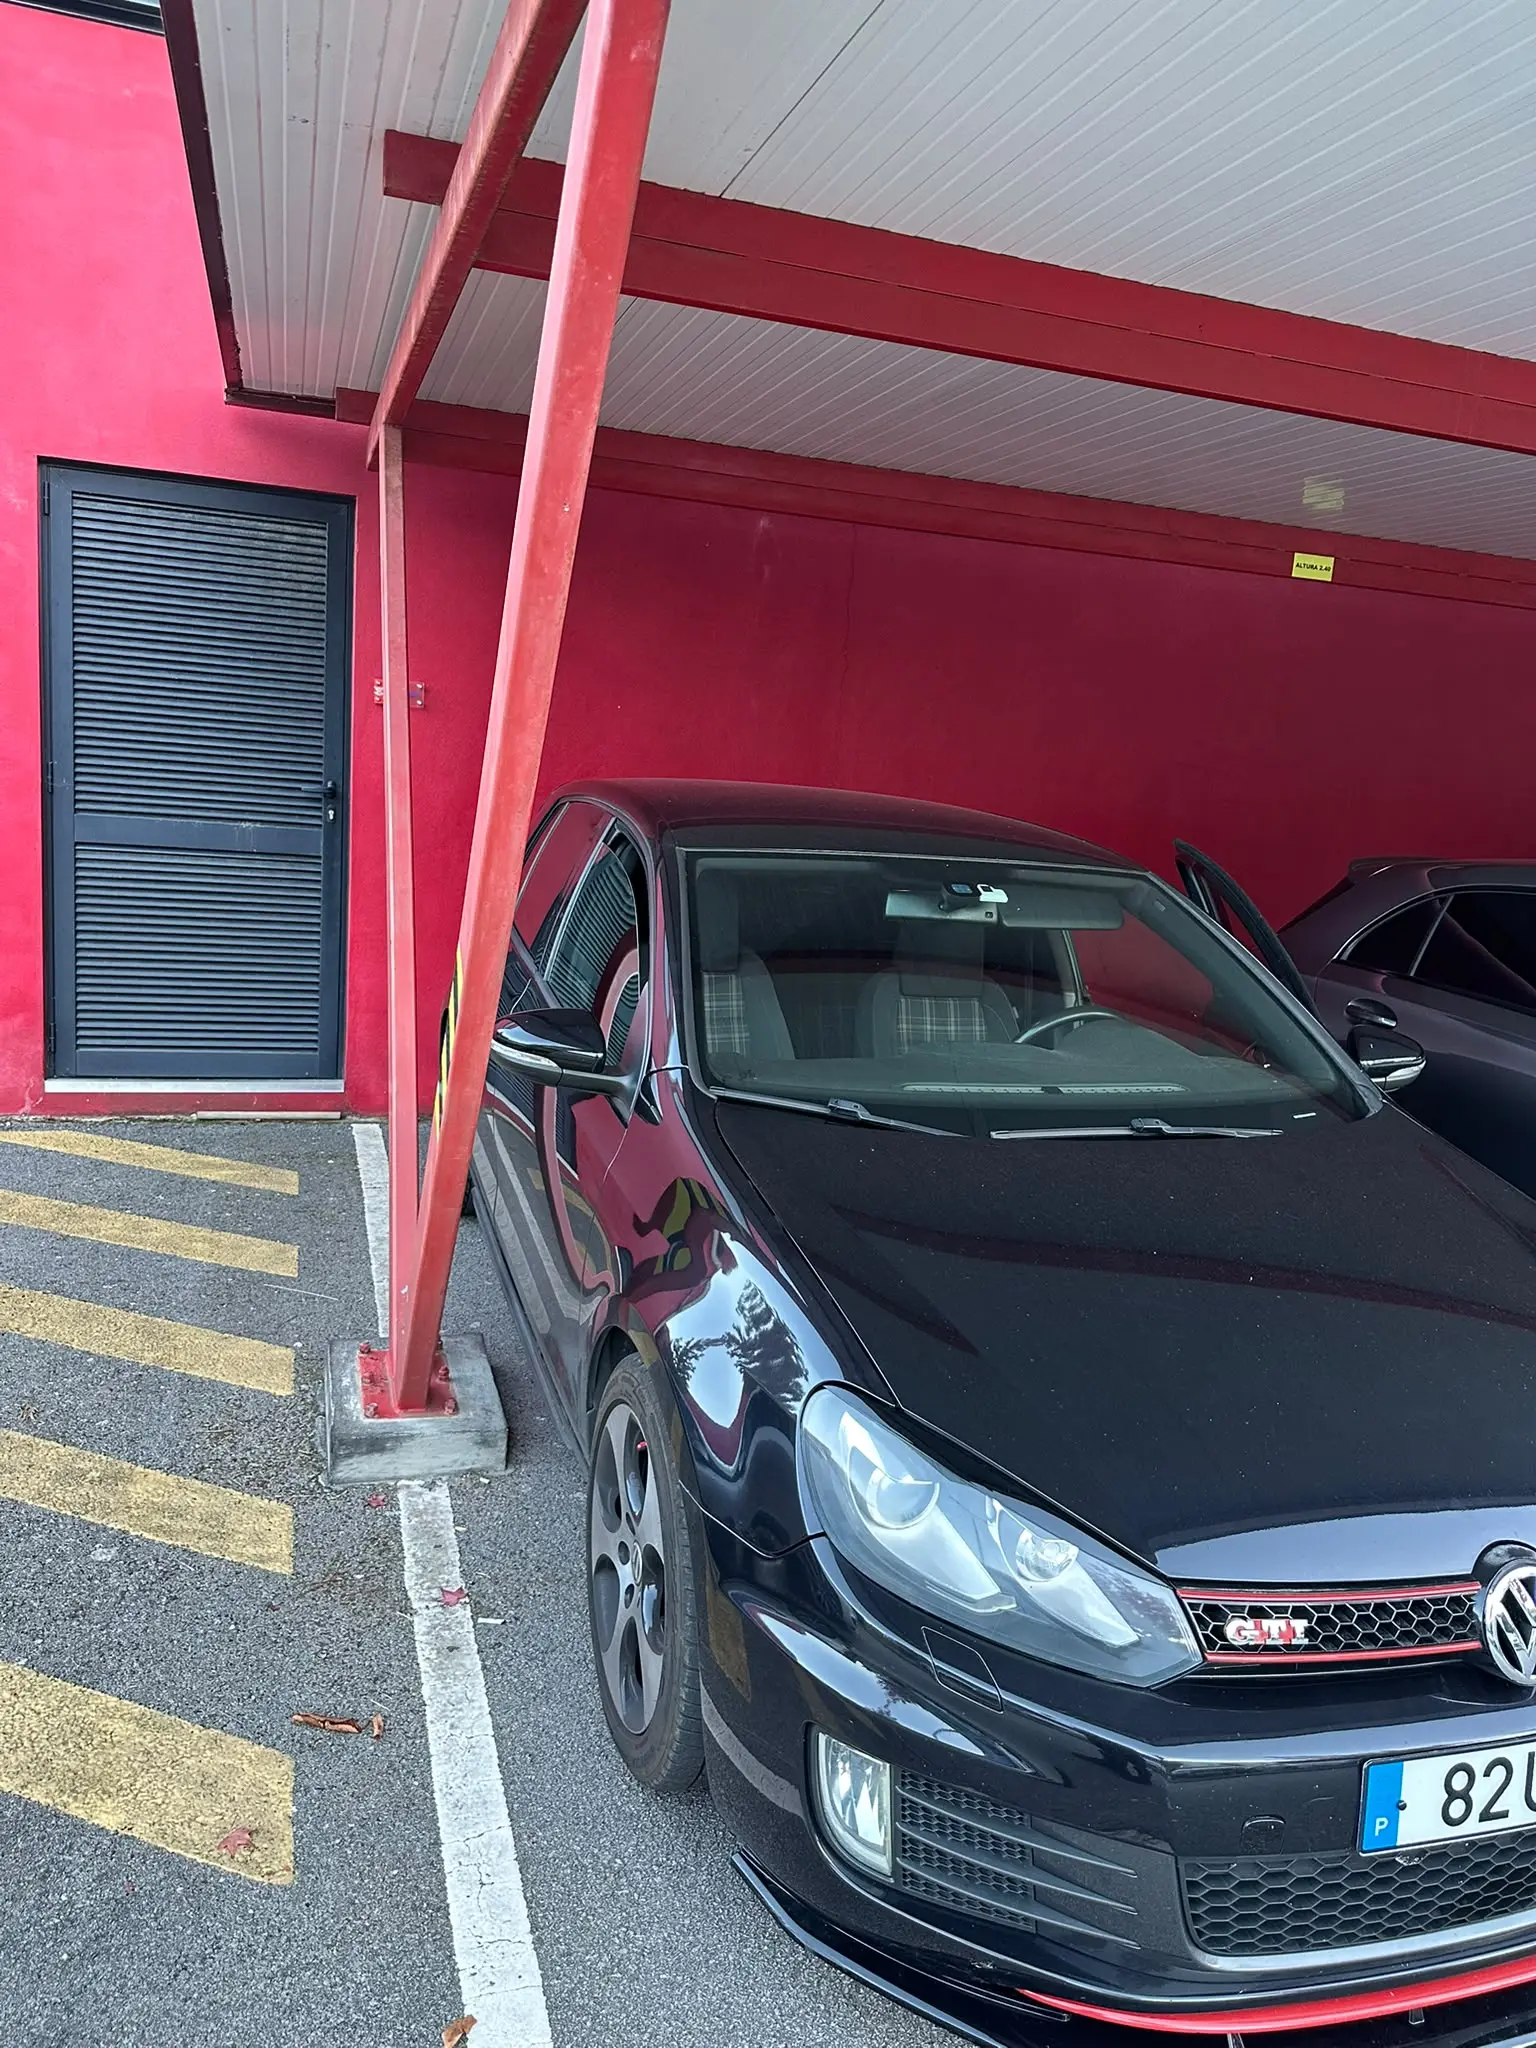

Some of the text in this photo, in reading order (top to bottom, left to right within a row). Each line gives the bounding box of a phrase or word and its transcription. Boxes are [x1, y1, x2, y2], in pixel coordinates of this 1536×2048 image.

[1295, 562, 1318, 570] ALTURA
[1224, 1617, 1309, 1645] GTI
[1374, 1817, 1389, 1837] P
